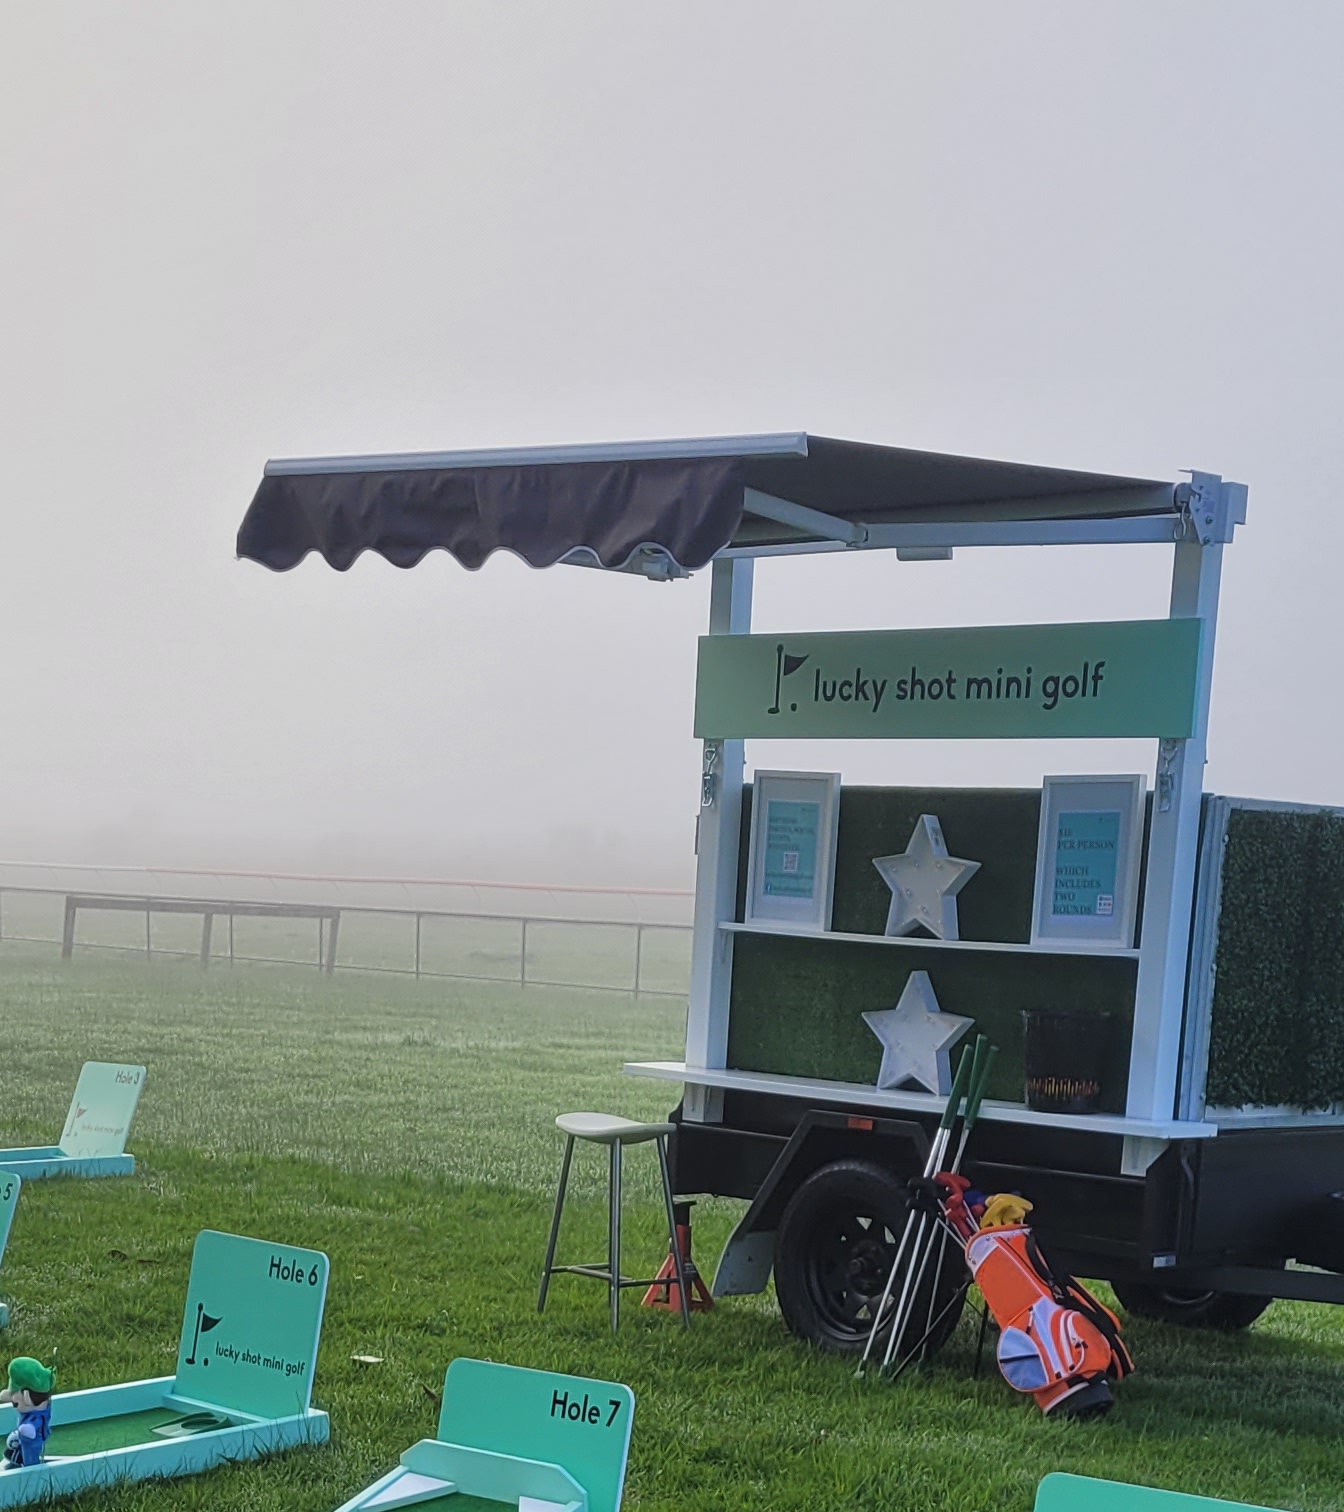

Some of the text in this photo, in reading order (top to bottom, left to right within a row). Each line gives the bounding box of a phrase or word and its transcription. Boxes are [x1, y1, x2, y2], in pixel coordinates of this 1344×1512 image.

[814, 661, 1105, 712] lucky shot mini golf
[1077, 840, 1115, 849] PERSON
[1056, 866, 1088, 876] WHICH
[1055, 880, 1101, 889] INCLUDES
[1054, 892, 1074, 902] TWO
[1052, 904, 1092, 915] ROUNDS
[116, 1071, 140, 1085] Hole 3
[3, 1183, 13, 1201] 5
[268, 1255, 318, 1286] Hole 6
[215, 1341, 305, 1376] lucky shot mini golf
[550, 1389, 621, 1427] Hole 7
